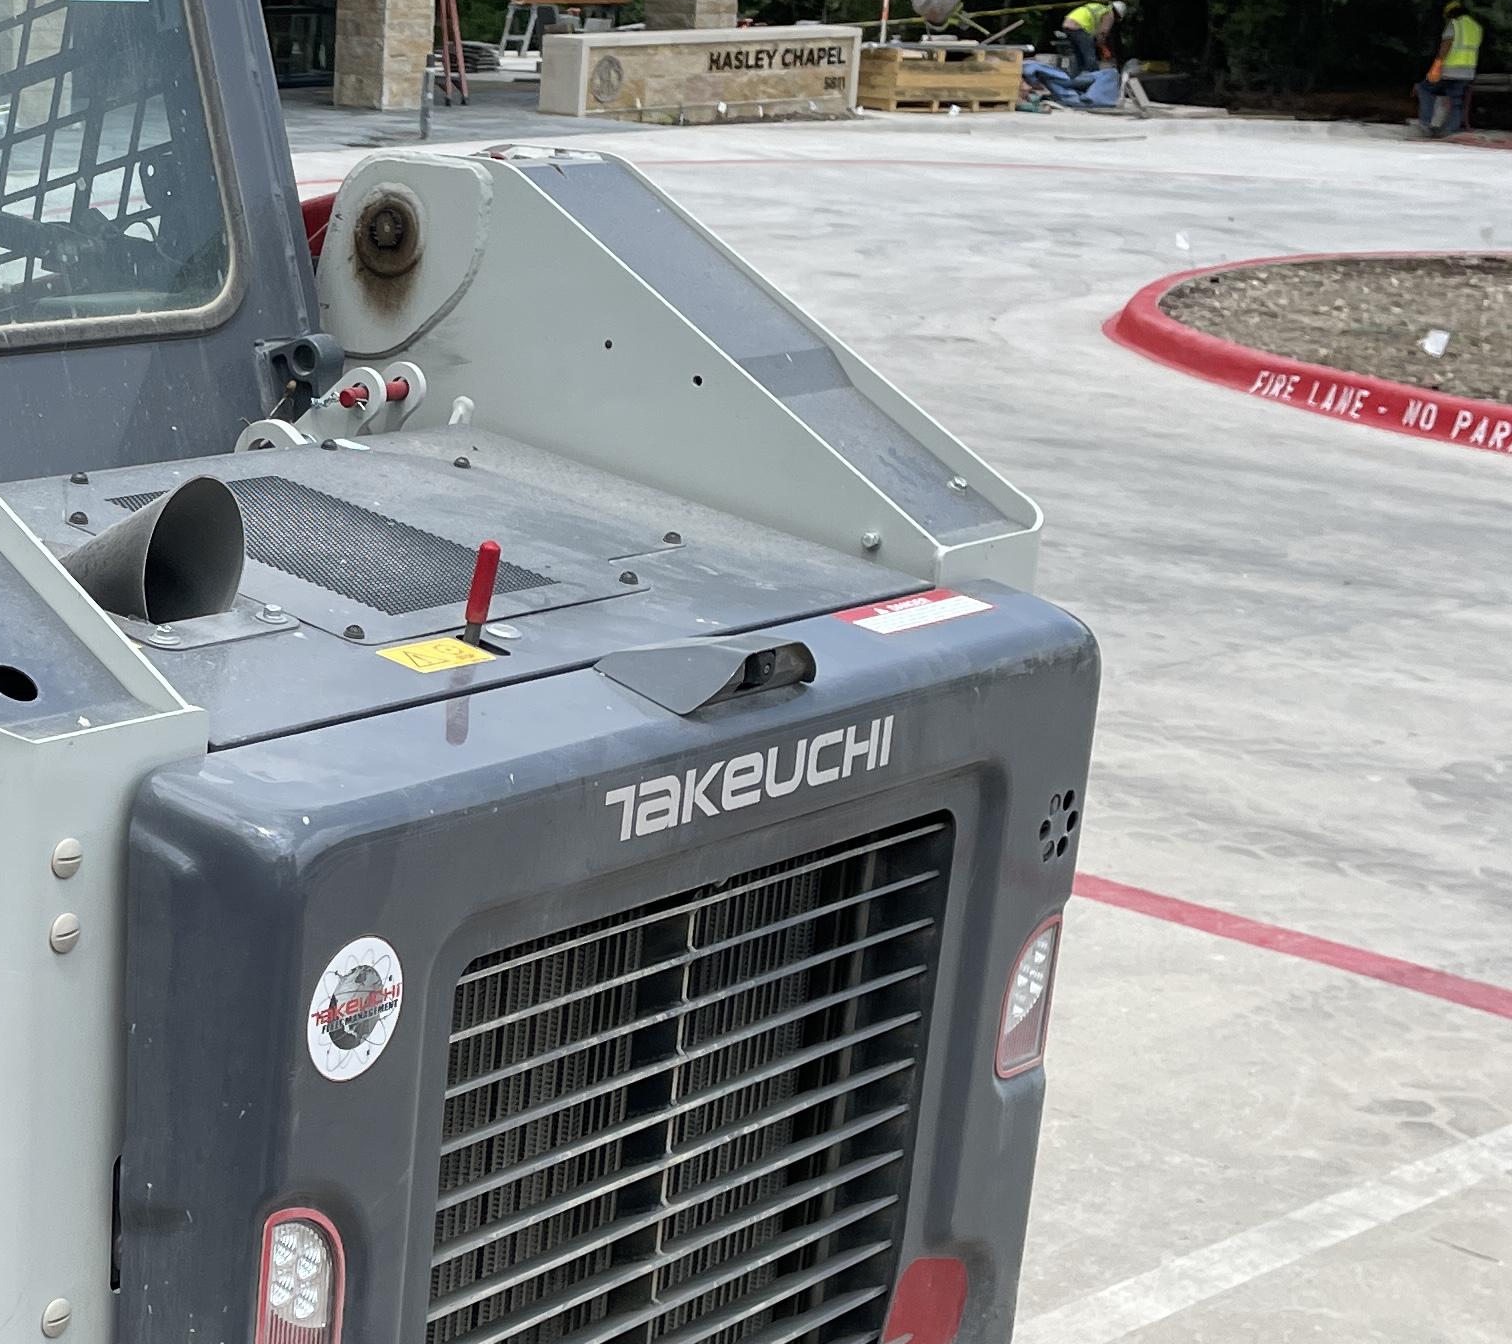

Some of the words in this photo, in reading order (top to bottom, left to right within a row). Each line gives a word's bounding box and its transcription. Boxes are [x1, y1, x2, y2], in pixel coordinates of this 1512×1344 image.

[782, 47, 846, 67] CHAPEL
[1248, 370, 1301, 401] FIRE
[1307, 380, 1371, 419] LANE
[1401, 399, 1439, 431] NO
[1449, 409, 1512, 453] PAR
